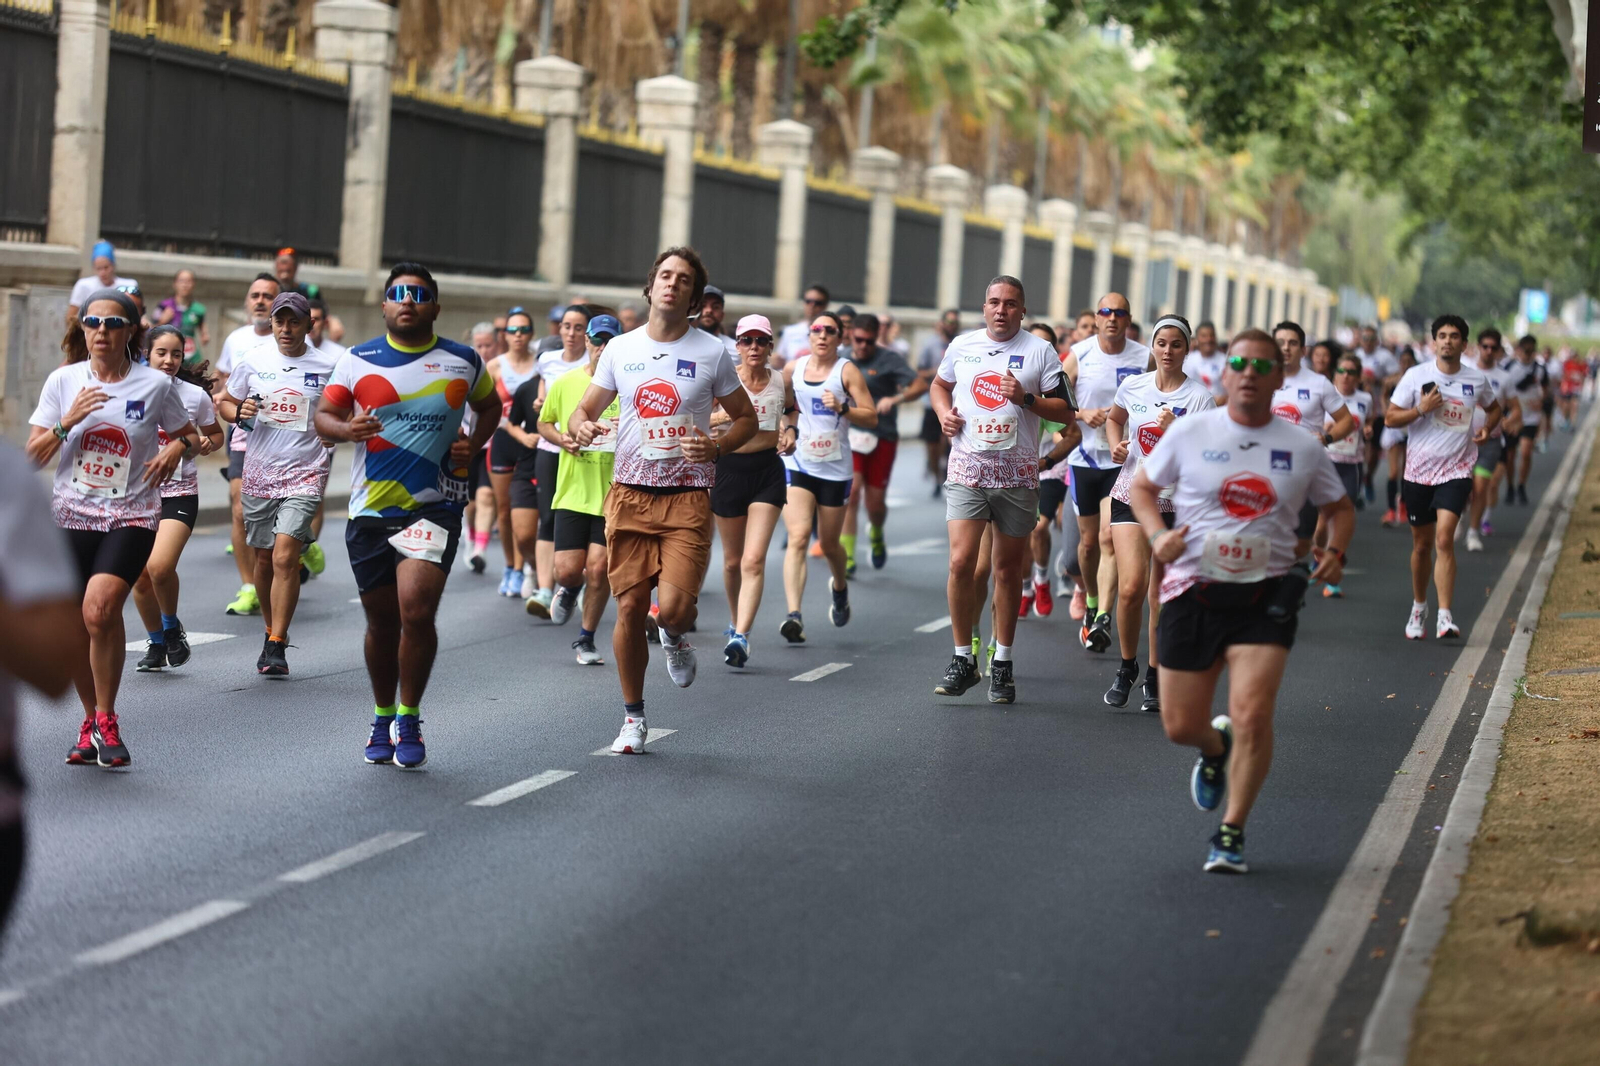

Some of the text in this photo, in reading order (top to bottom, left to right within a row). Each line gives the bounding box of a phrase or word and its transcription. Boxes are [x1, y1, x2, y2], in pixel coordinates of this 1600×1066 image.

[676, 367, 693, 377] AXA
[977, 379, 1001, 393] PONL
[641, 388, 675, 407] PONLE
[975, 386, 1004, 402] FRENO
[271, 402, 297, 413] 269
[638, 397, 671, 415] FRENO
[396, 412, 447, 424] Málaga
[1443, 410, 1463, 420] 201
[408, 423, 444, 432] 2024
[648, 425, 687, 440] 1190
[977, 424, 1011, 434] 1247
[1142, 429, 1161, 442] PON
[89, 434, 125, 452] PONLE
[810, 440, 832, 449] 460
[1141, 437, 1157, 448] FRE
[83, 462, 114, 478] 479
[402, 527, 433, 541] 391
[1218, 543, 1253, 560] 991
